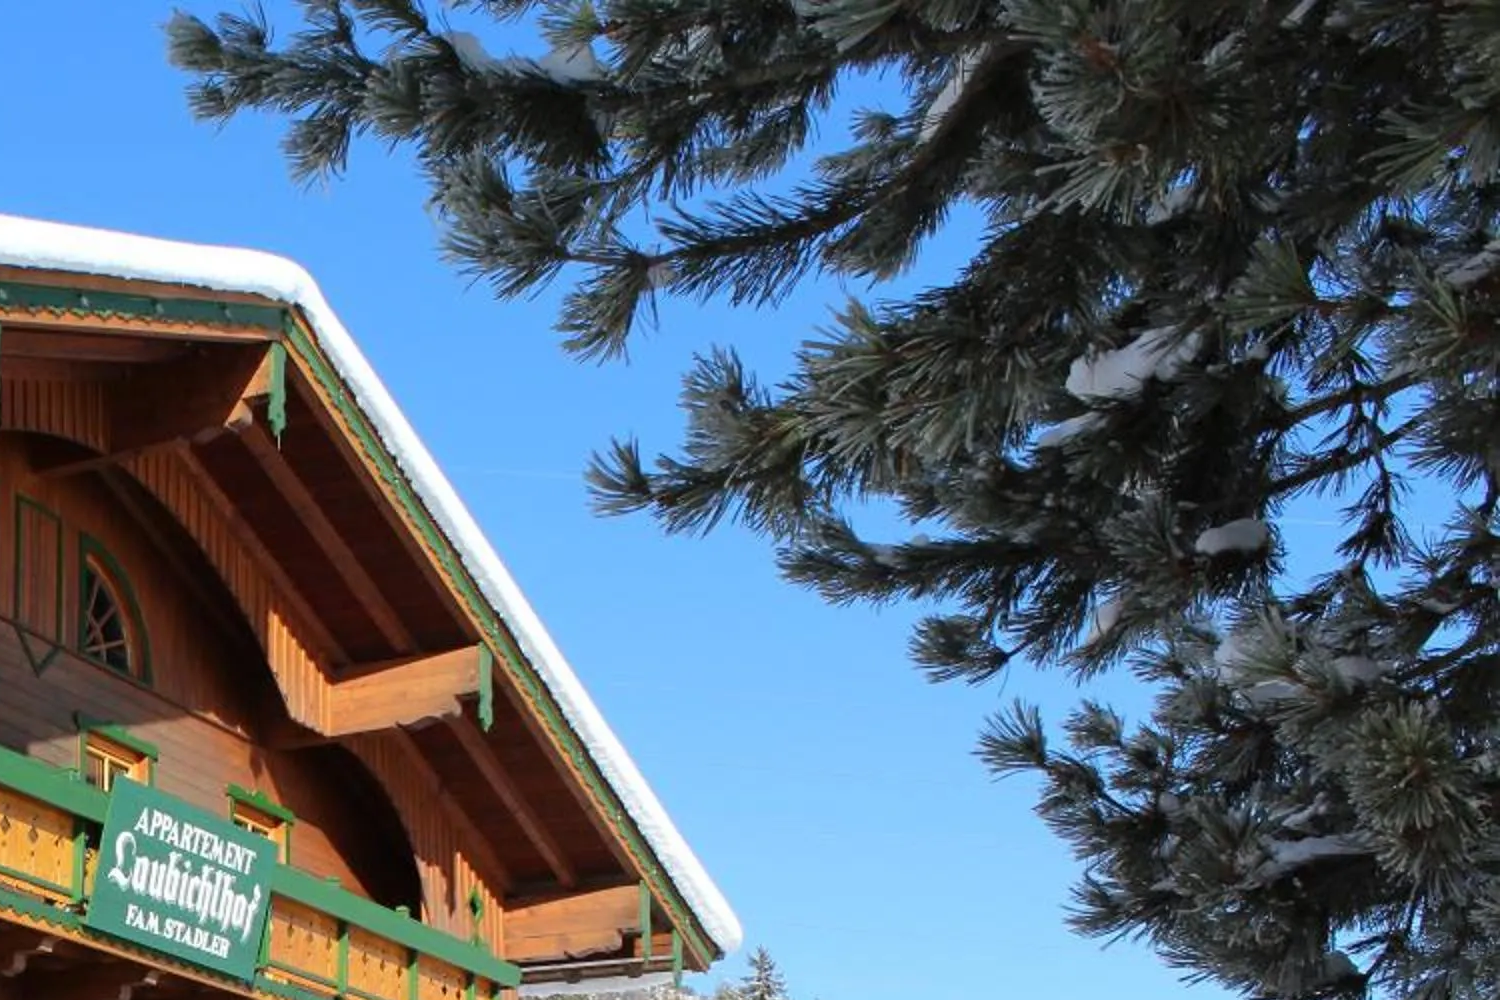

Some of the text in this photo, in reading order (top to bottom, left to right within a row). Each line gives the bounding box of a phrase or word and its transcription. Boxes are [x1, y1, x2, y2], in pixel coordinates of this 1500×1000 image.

[134, 807, 257, 875] APPARTEMENT
[107, 831, 261, 943] Laubichlhof
[164, 917, 231, 958] STADLER
